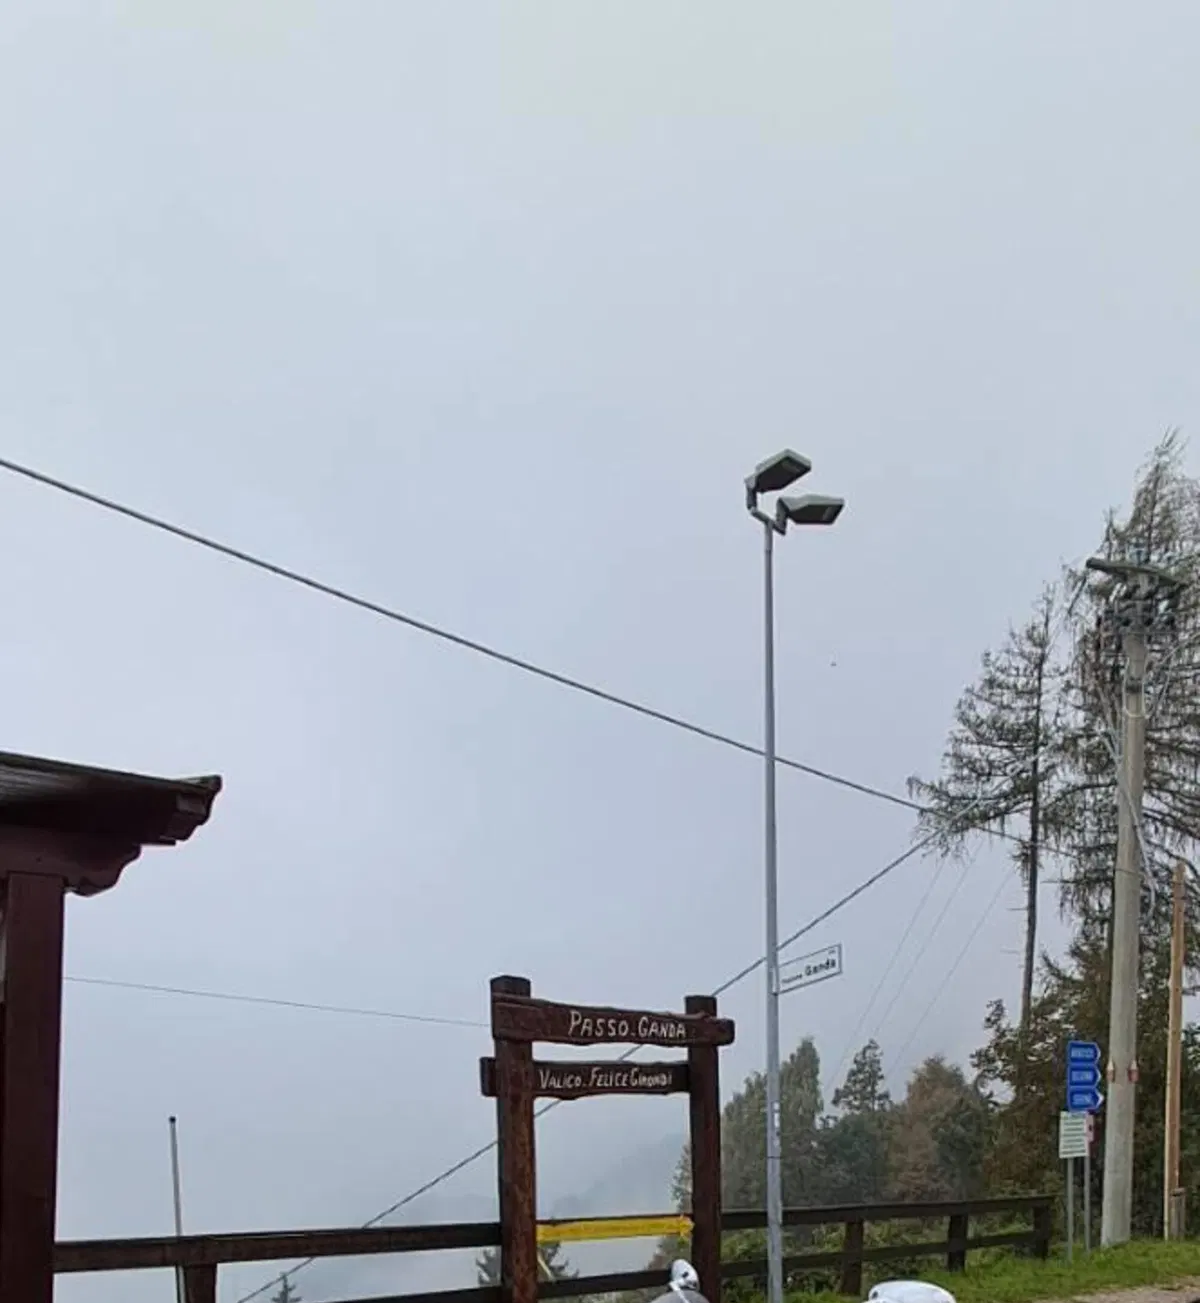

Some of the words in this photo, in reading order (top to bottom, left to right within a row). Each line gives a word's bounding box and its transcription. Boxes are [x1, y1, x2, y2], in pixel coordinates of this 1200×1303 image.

[804, 957, 837, 976] Ganda
[568, 1010, 629, 1037] PASSO
[638, 1015, 687, 1038] GANDA
[588, 1066, 629, 1087] FELICE
